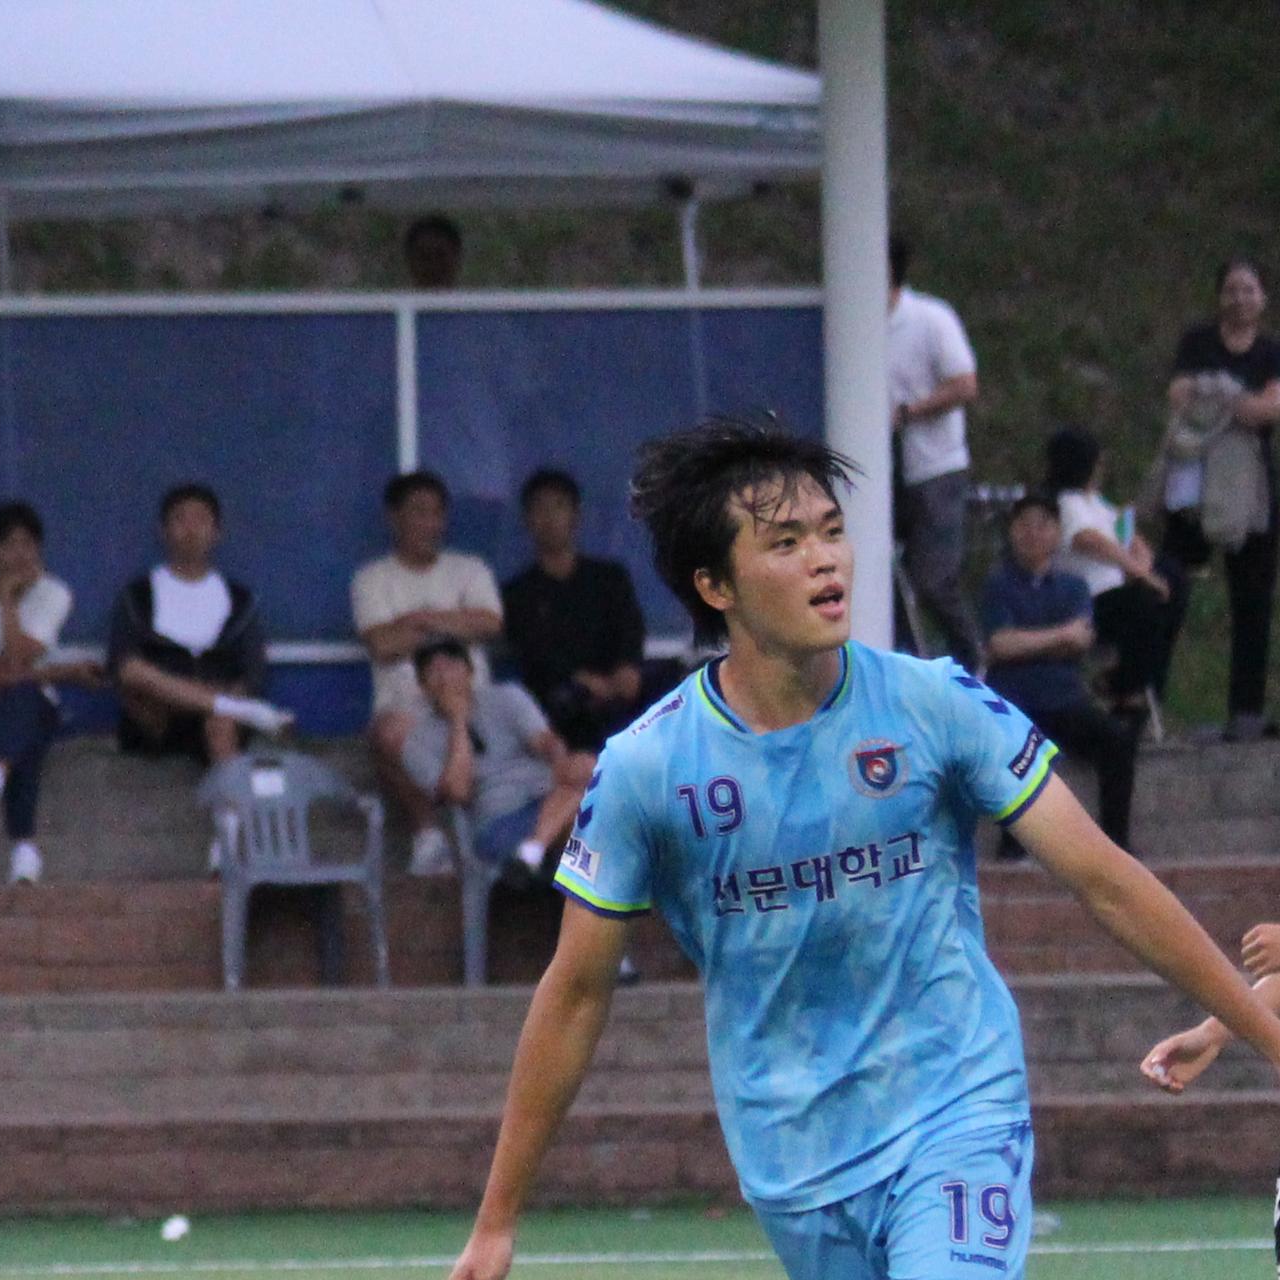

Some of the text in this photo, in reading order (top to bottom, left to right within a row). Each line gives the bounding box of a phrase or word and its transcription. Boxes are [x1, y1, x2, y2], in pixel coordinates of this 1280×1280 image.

[677, 775, 745, 838] 19
[711, 830, 928, 918] 선문대학교
[940, 1180, 1016, 1250] 19
